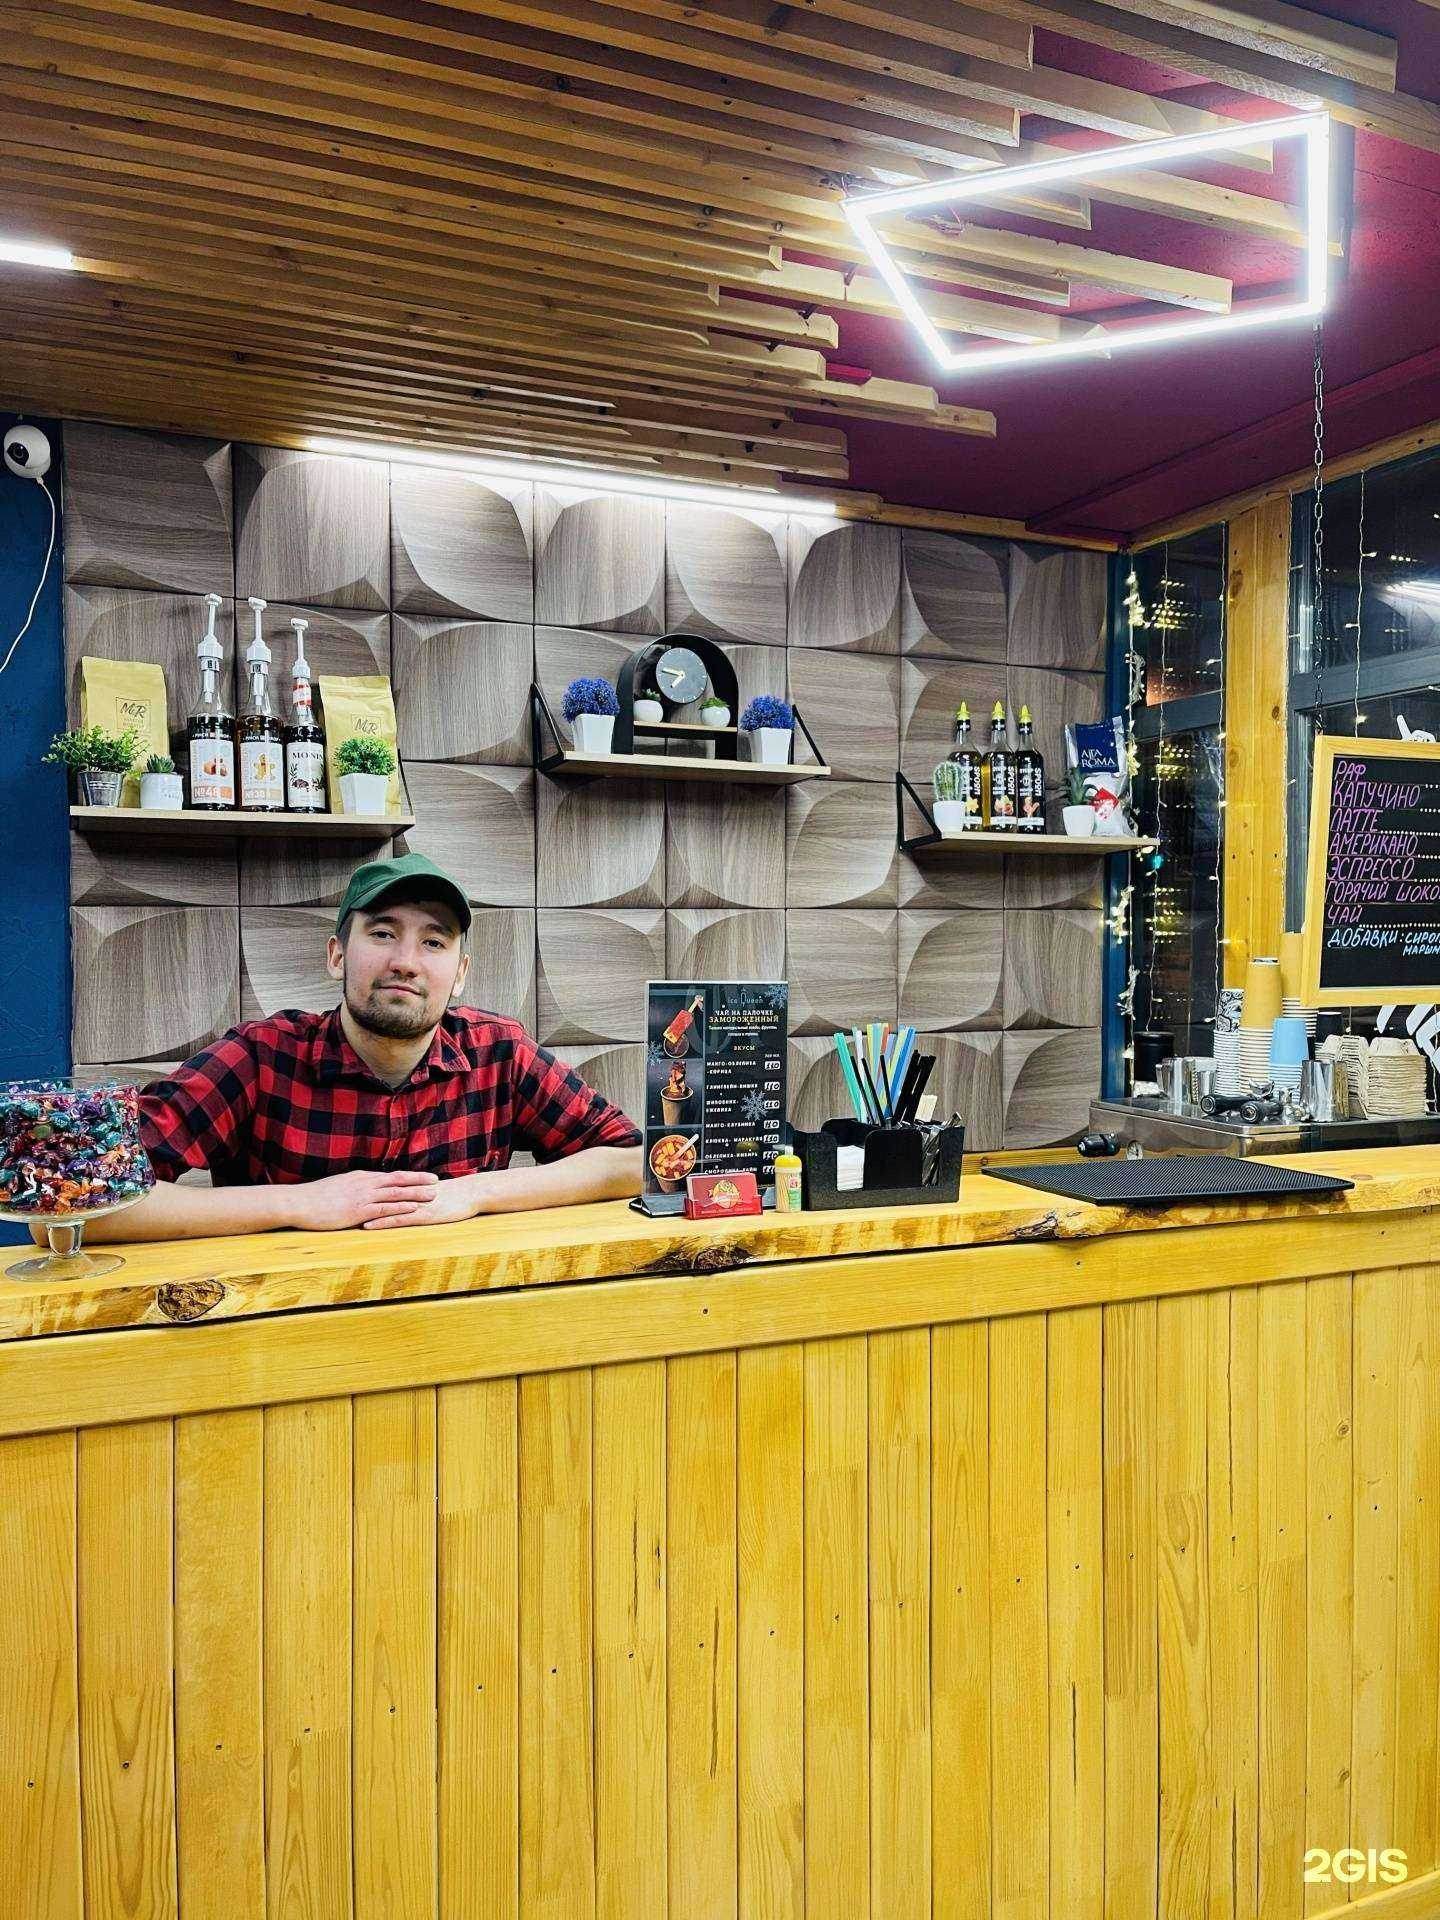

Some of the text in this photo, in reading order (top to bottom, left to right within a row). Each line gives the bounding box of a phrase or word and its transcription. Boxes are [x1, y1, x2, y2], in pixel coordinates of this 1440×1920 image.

[1082, 756, 1115, 768] ROMA
[1334, 760, 1367, 782] РАФ
[1332, 780, 1421, 809] КАПУЧИНО
[1330, 808, 1383, 832] ЛАТТЕ
[1329, 833, 1418, 856] АМЕРИКАНО
[1327, 856, 1415, 880] ЭСПРЕССО
[1325, 880, 1440, 903] ГОРЯЧИЙ ШОКО
[1328, 904, 1363, 925] ЧАЙ
[709, 1015, 779, 1023] ЗАМОРОЖЕННЫЙ
